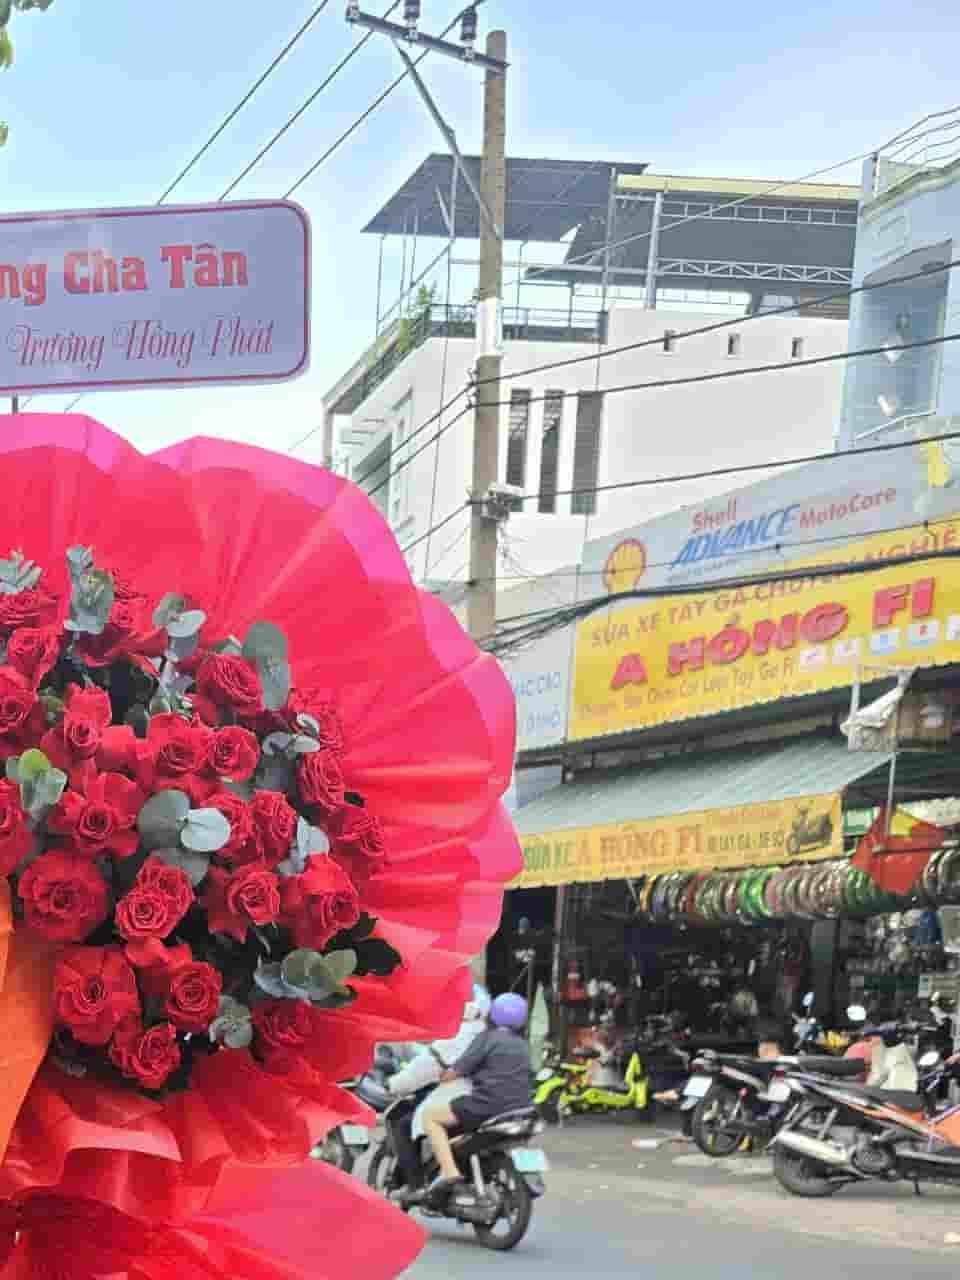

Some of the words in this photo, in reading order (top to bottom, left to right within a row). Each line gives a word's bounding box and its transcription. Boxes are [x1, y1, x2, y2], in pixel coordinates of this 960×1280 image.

[64, 246, 147, 294] Cha
[159, 242, 249, 289] Tân
[671, 504, 801, 568] ADVANCE
[691, 497, 738, 533] Shell
[610, 653, 649, 690] A
[872, 576, 937, 630] FI
